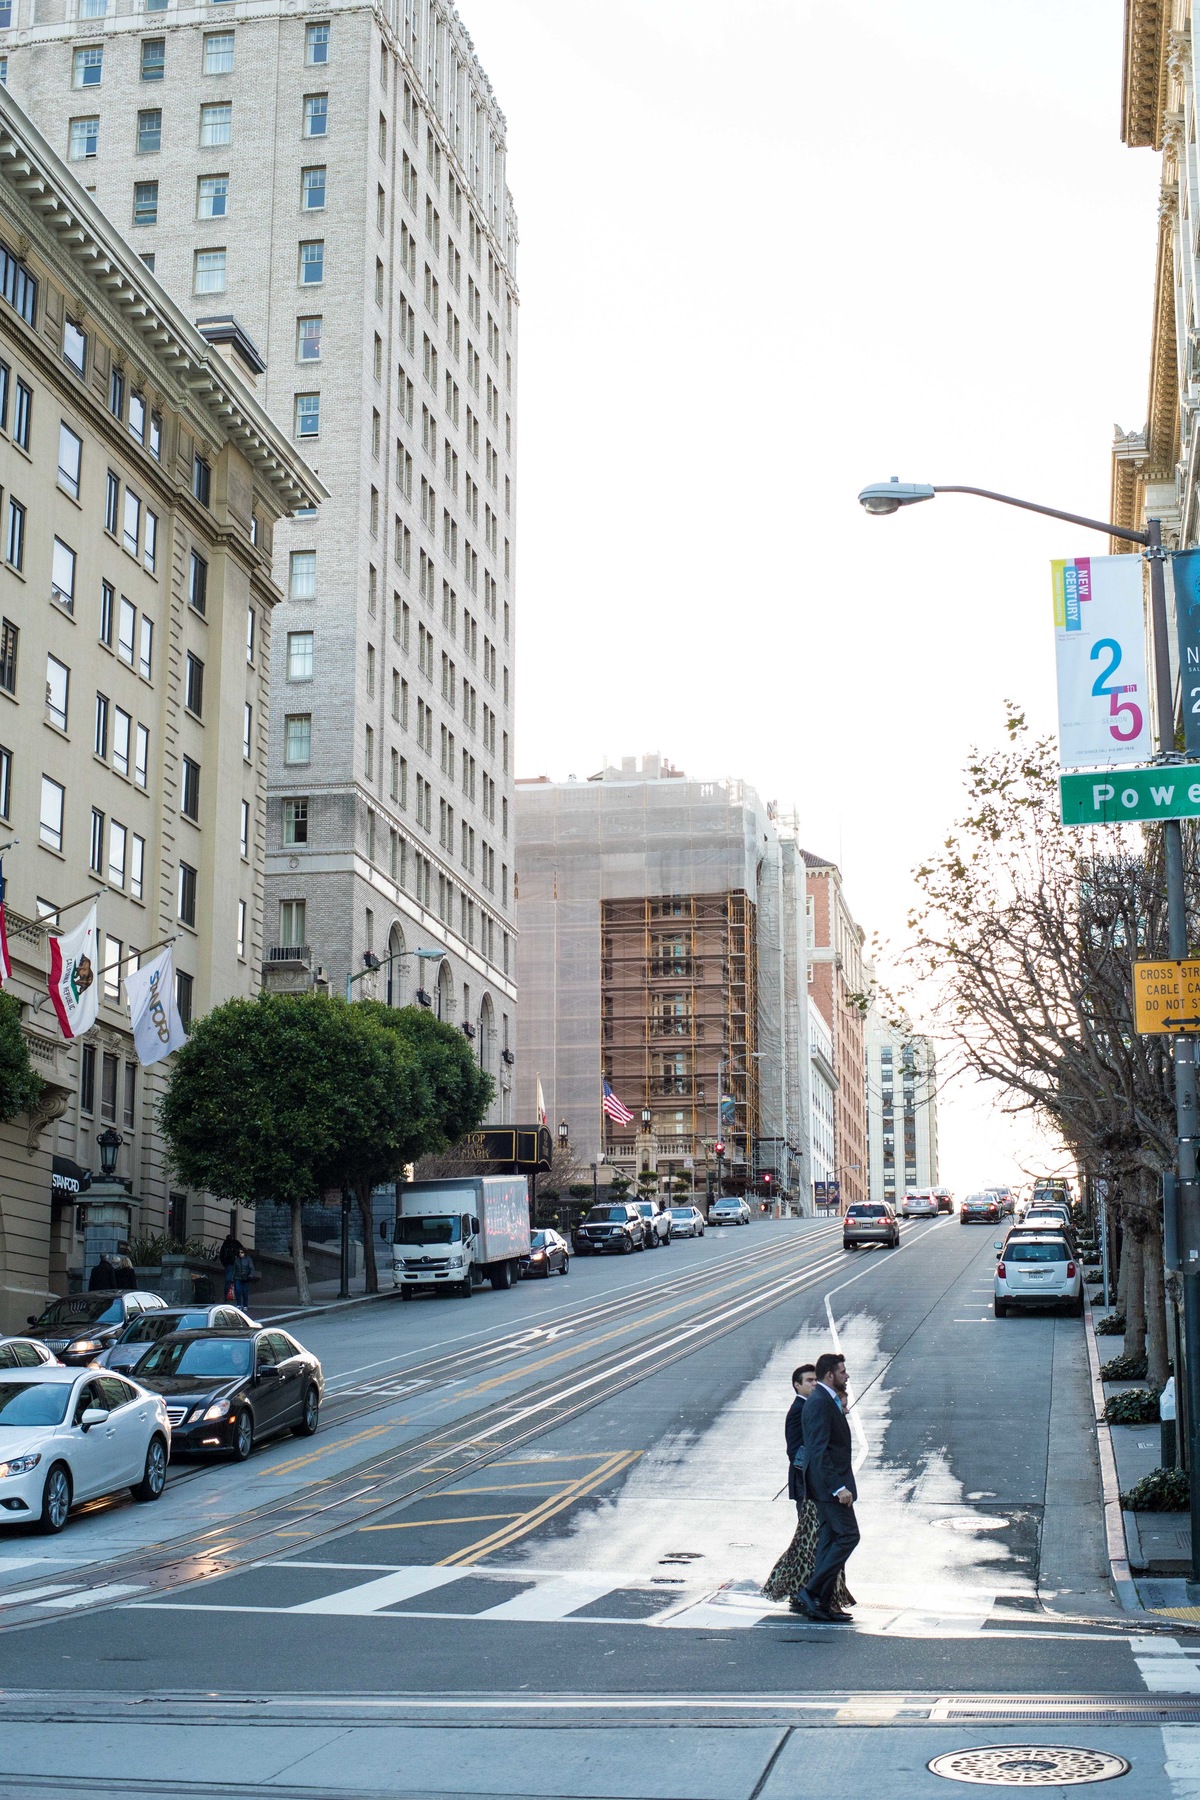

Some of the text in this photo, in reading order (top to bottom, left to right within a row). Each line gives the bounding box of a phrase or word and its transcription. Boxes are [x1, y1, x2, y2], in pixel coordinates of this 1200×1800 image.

[1077, 570, 1089, 595] NEW
[1065, 570, 1079, 621] CENTURY
[1101, 716, 1128, 725] SEASON
[1092, 783, 1200, 810] Powe
[1140, 969, 1173, 979] CROSS
[1146, 984, 1179, 995] CABLE
[63, 986, 76, 1011] REPUBLIC
[1145, 1000, 1159, 1011] DO
[1166, 999, 1186, 1010] NOT
[466, 1133, 486, 1144] TOP
[52, 1173, 80, 1193] STANFORD
